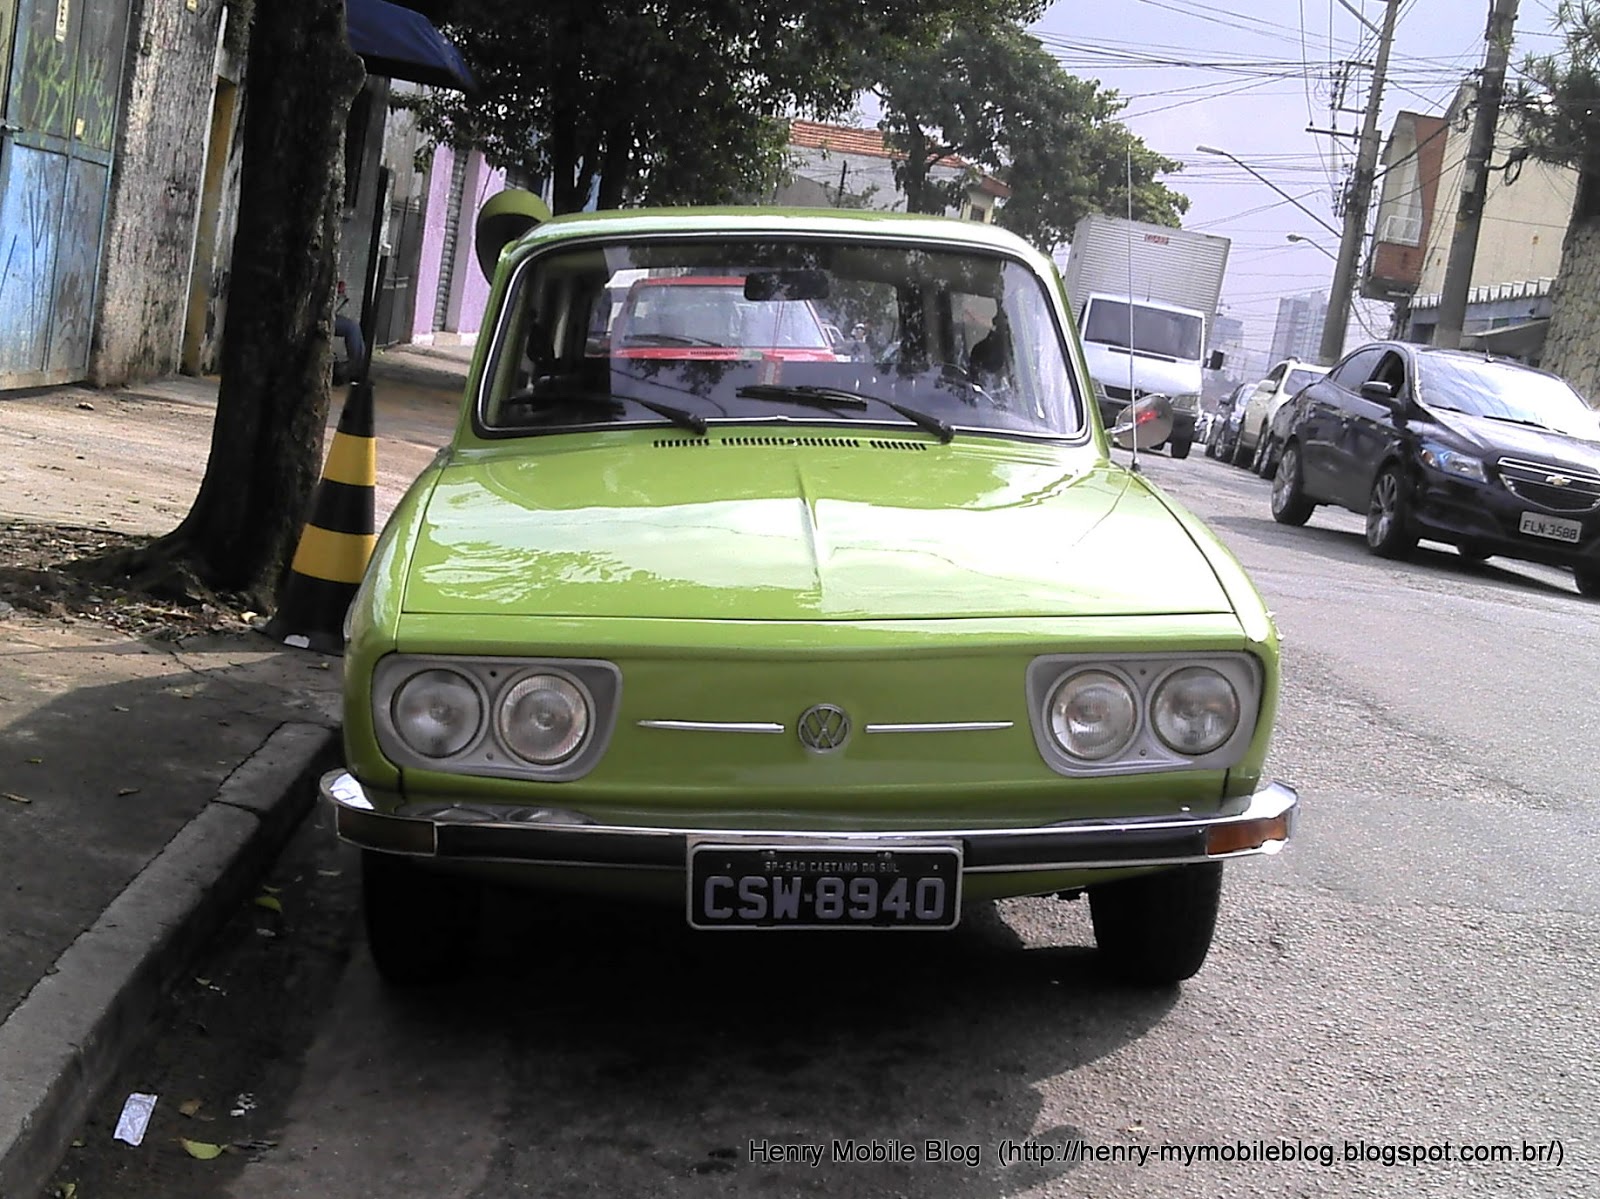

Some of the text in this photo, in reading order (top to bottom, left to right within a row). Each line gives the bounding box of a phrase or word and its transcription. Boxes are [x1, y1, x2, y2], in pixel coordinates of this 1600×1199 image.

[810, 862, 859, 873] CAETANO
[862, 862, 876, 872] DO
[879, 862, 900, 873] SUL
